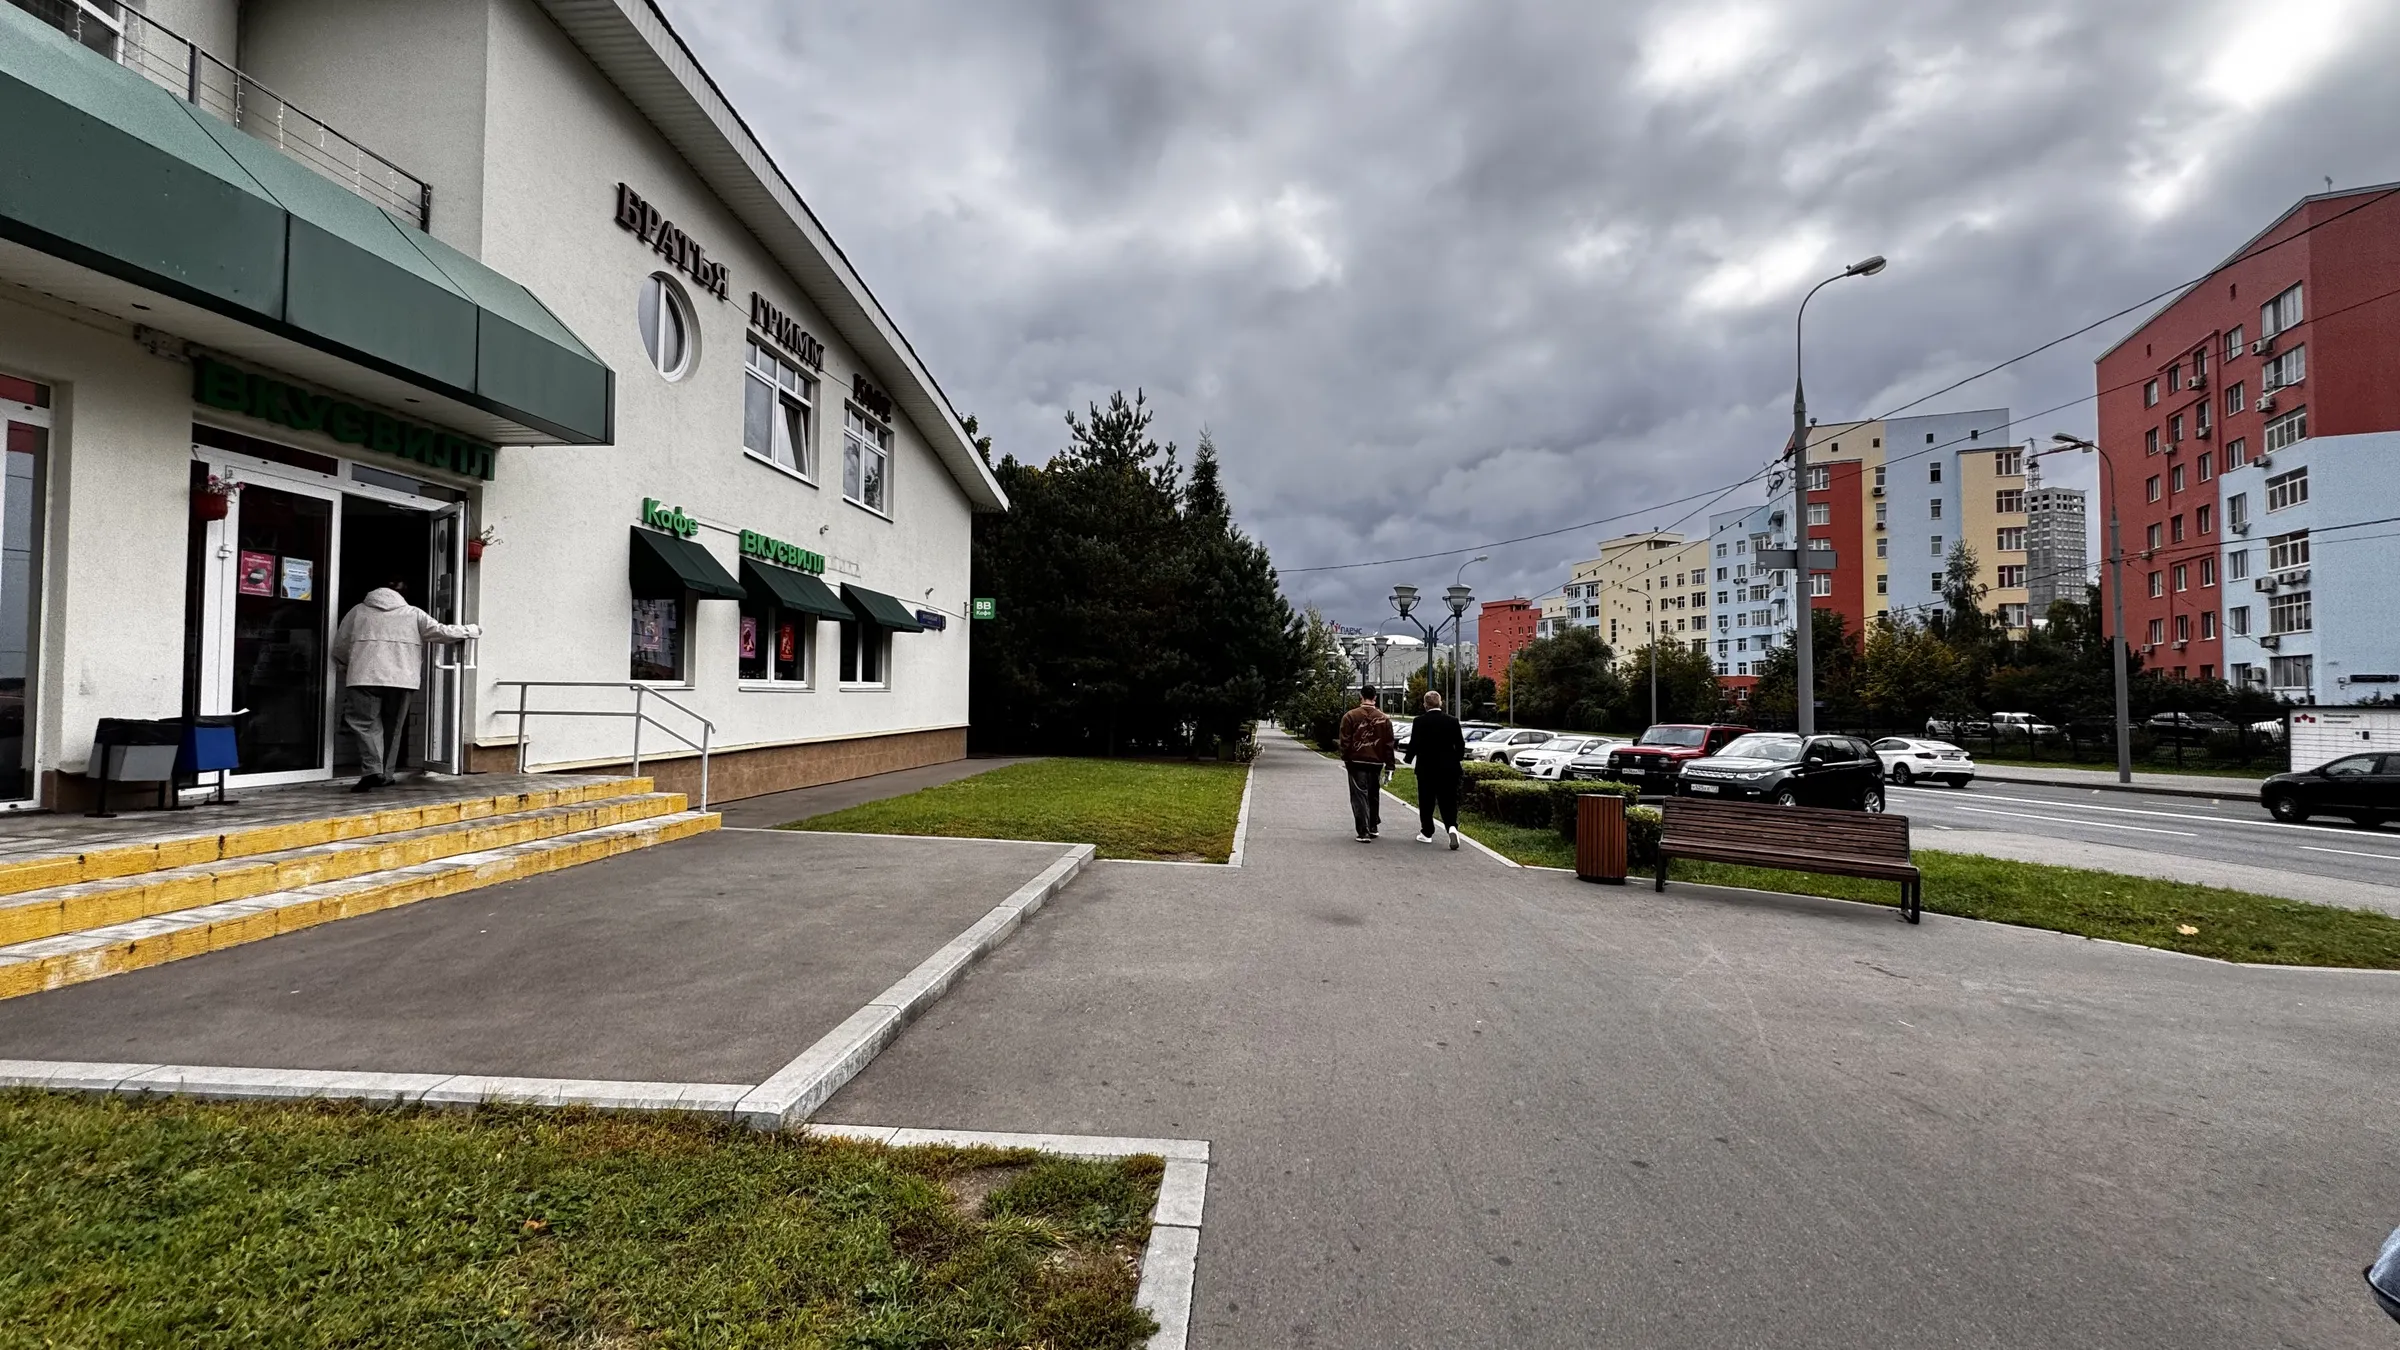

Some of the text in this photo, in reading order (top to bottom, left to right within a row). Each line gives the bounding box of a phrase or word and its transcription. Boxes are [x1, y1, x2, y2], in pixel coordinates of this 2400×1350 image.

[615, 182, 731, 300] БРАТЬЯ
[750, 291, 825, 371] ГРИММ
[642, 497, 699, 537] Кафе
[1340, 626, 1363, 634] ПАРУС
